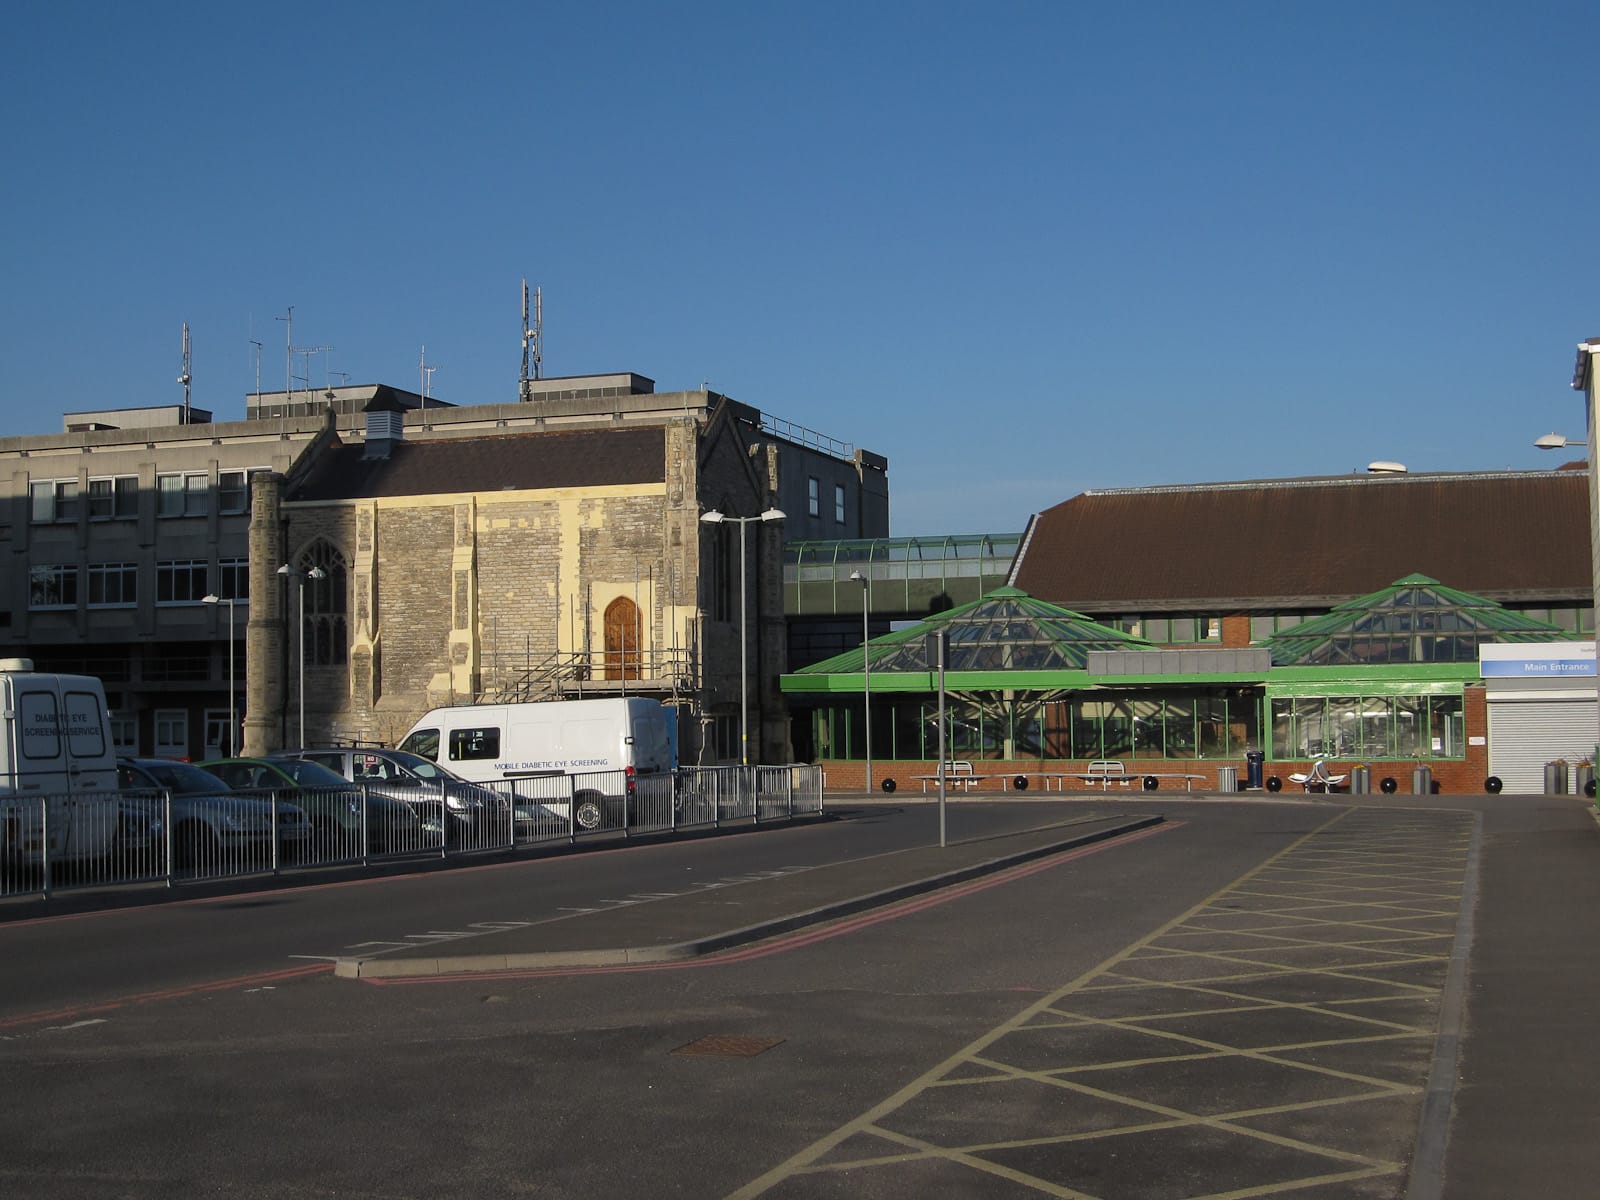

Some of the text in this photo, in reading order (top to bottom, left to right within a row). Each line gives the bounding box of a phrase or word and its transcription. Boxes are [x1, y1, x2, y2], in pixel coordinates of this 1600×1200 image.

[1524, 663, 1590, 671] Main Entrance
[72, 713, 88, 722] EYE
[67, 727, 100, 736] SERVICE
[521, 761, 552, 769] DIABETIC
[570, 759, 608, 767] SCREENING
